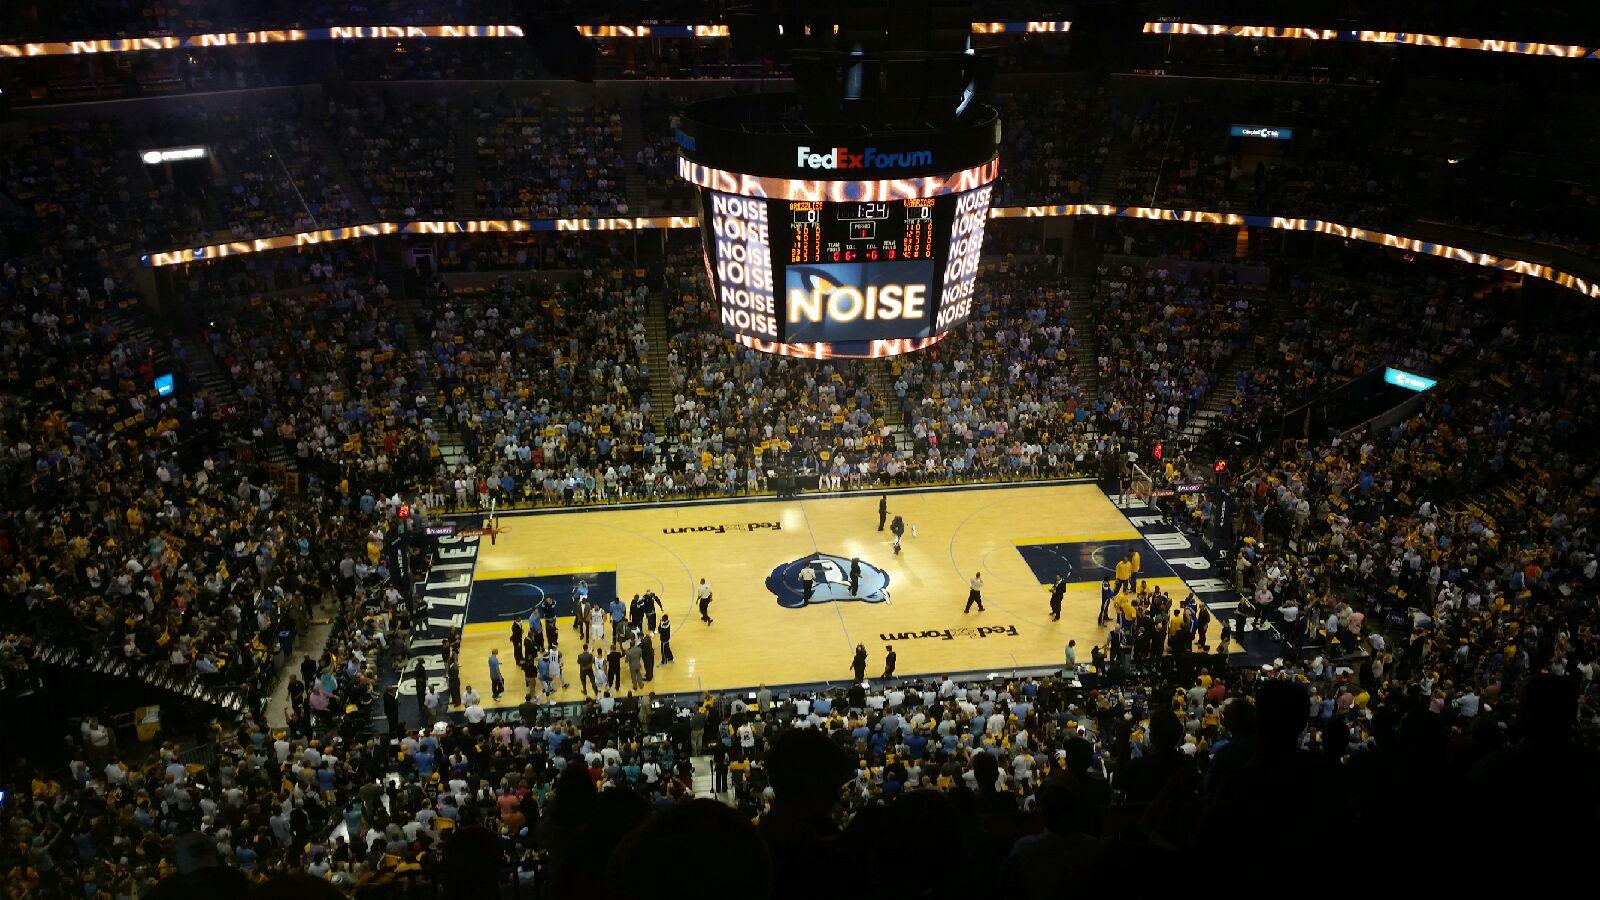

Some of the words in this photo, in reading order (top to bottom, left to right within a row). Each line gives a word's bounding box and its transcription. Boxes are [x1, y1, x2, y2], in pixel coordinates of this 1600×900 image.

[797, 146, 932, 170] FedExForum
[712, 195, 768, 222] NOISE
[808, 210, 815, 222] 0
[858, 203, 886, 218] 1:24
[921, 206, 929, 218] 0
[956, 186, 993, 216] NOISE
[713, 217, 769, 246] NOISE
[952, 208, 988, 238] NOISE
[718, 239, 772, 269] NOISE
[949, 231, 985, 260] NOISE
[717, 261, 774, 292] NOISE
[944, 252, 980, 284] NOISE
[721, 286, 775, 314] NOISE
[788, 283, 927, 324] NOISE
[941, 276, 976, 306] NOISE
[721, 306, 777, 336] NOISE
[935, 298, 972, 331] NOISE
